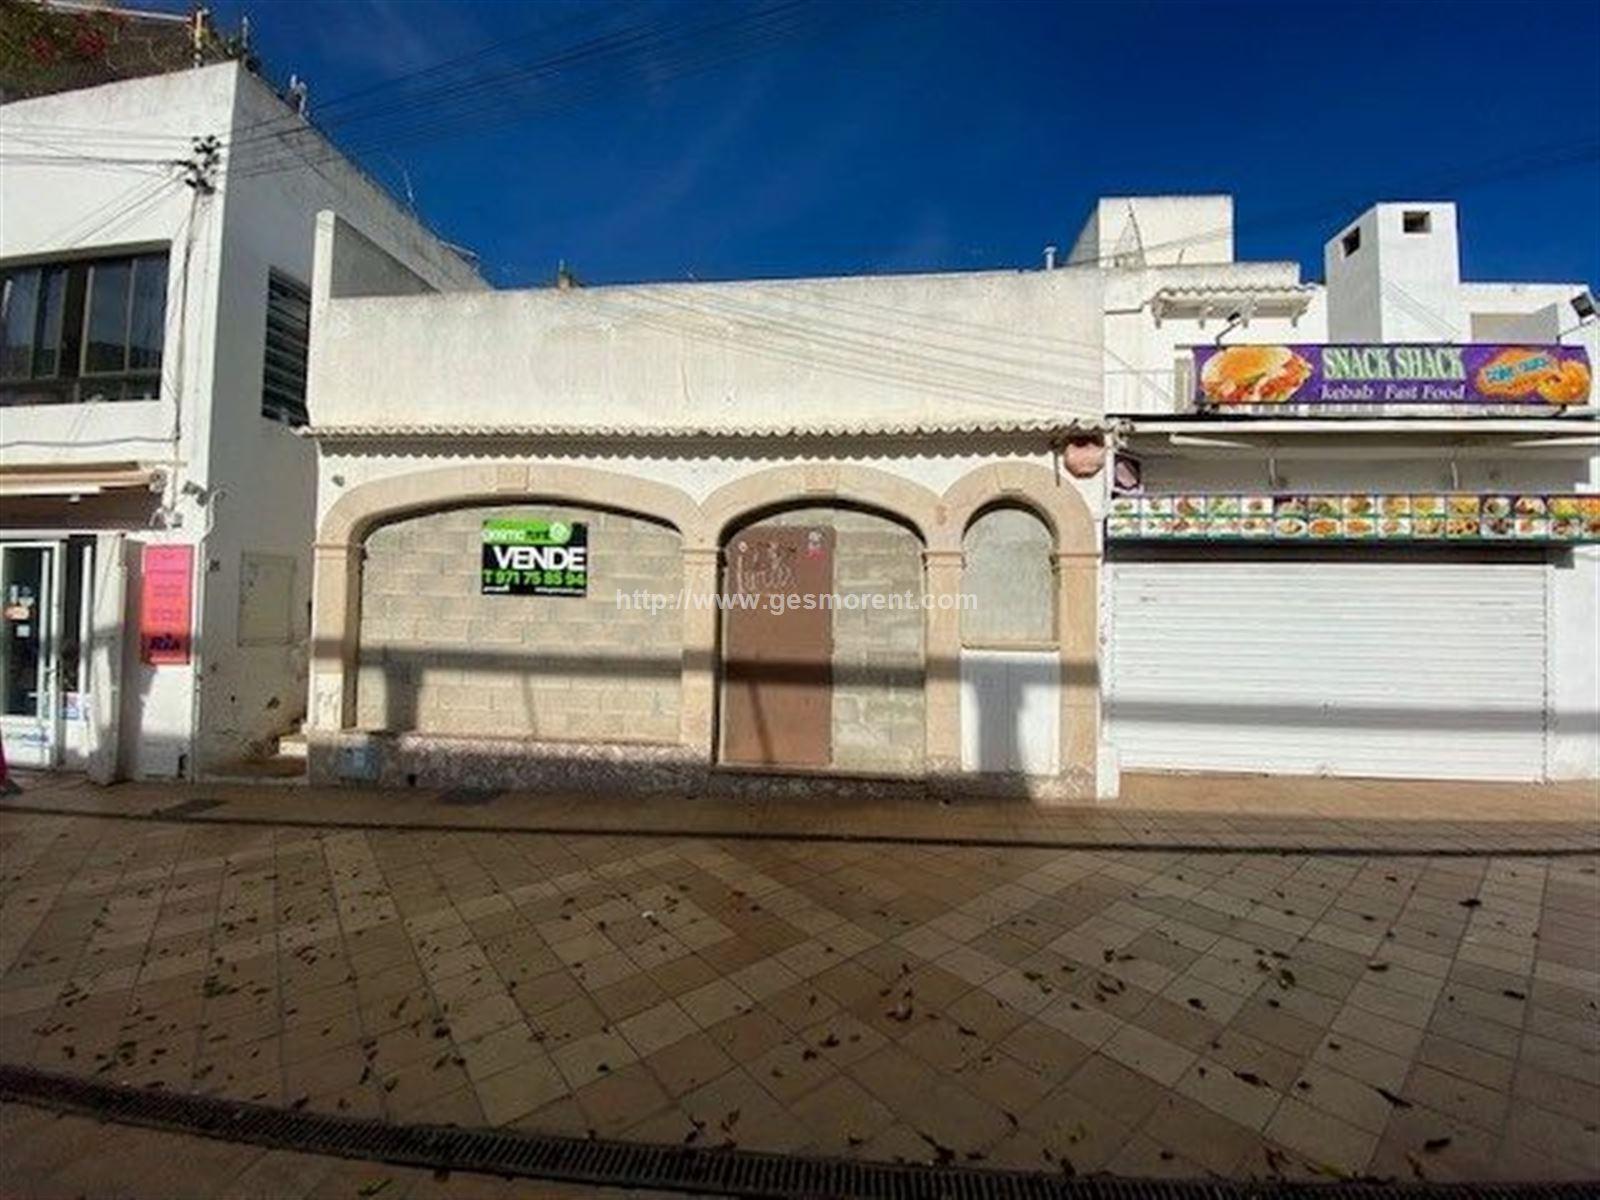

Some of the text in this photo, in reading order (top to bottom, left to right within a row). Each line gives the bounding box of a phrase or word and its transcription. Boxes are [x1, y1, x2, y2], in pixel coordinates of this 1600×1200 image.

[1322, 347, 1392, 379] SNACK
[1394, 347, 1465, 380] SHACK
[1385, 384, 1418, 400] Fast
[1422, 384, 1465, 400] Food
[493, 546, 585, 570] VENDE
[495, 570, 519, 584] 971
